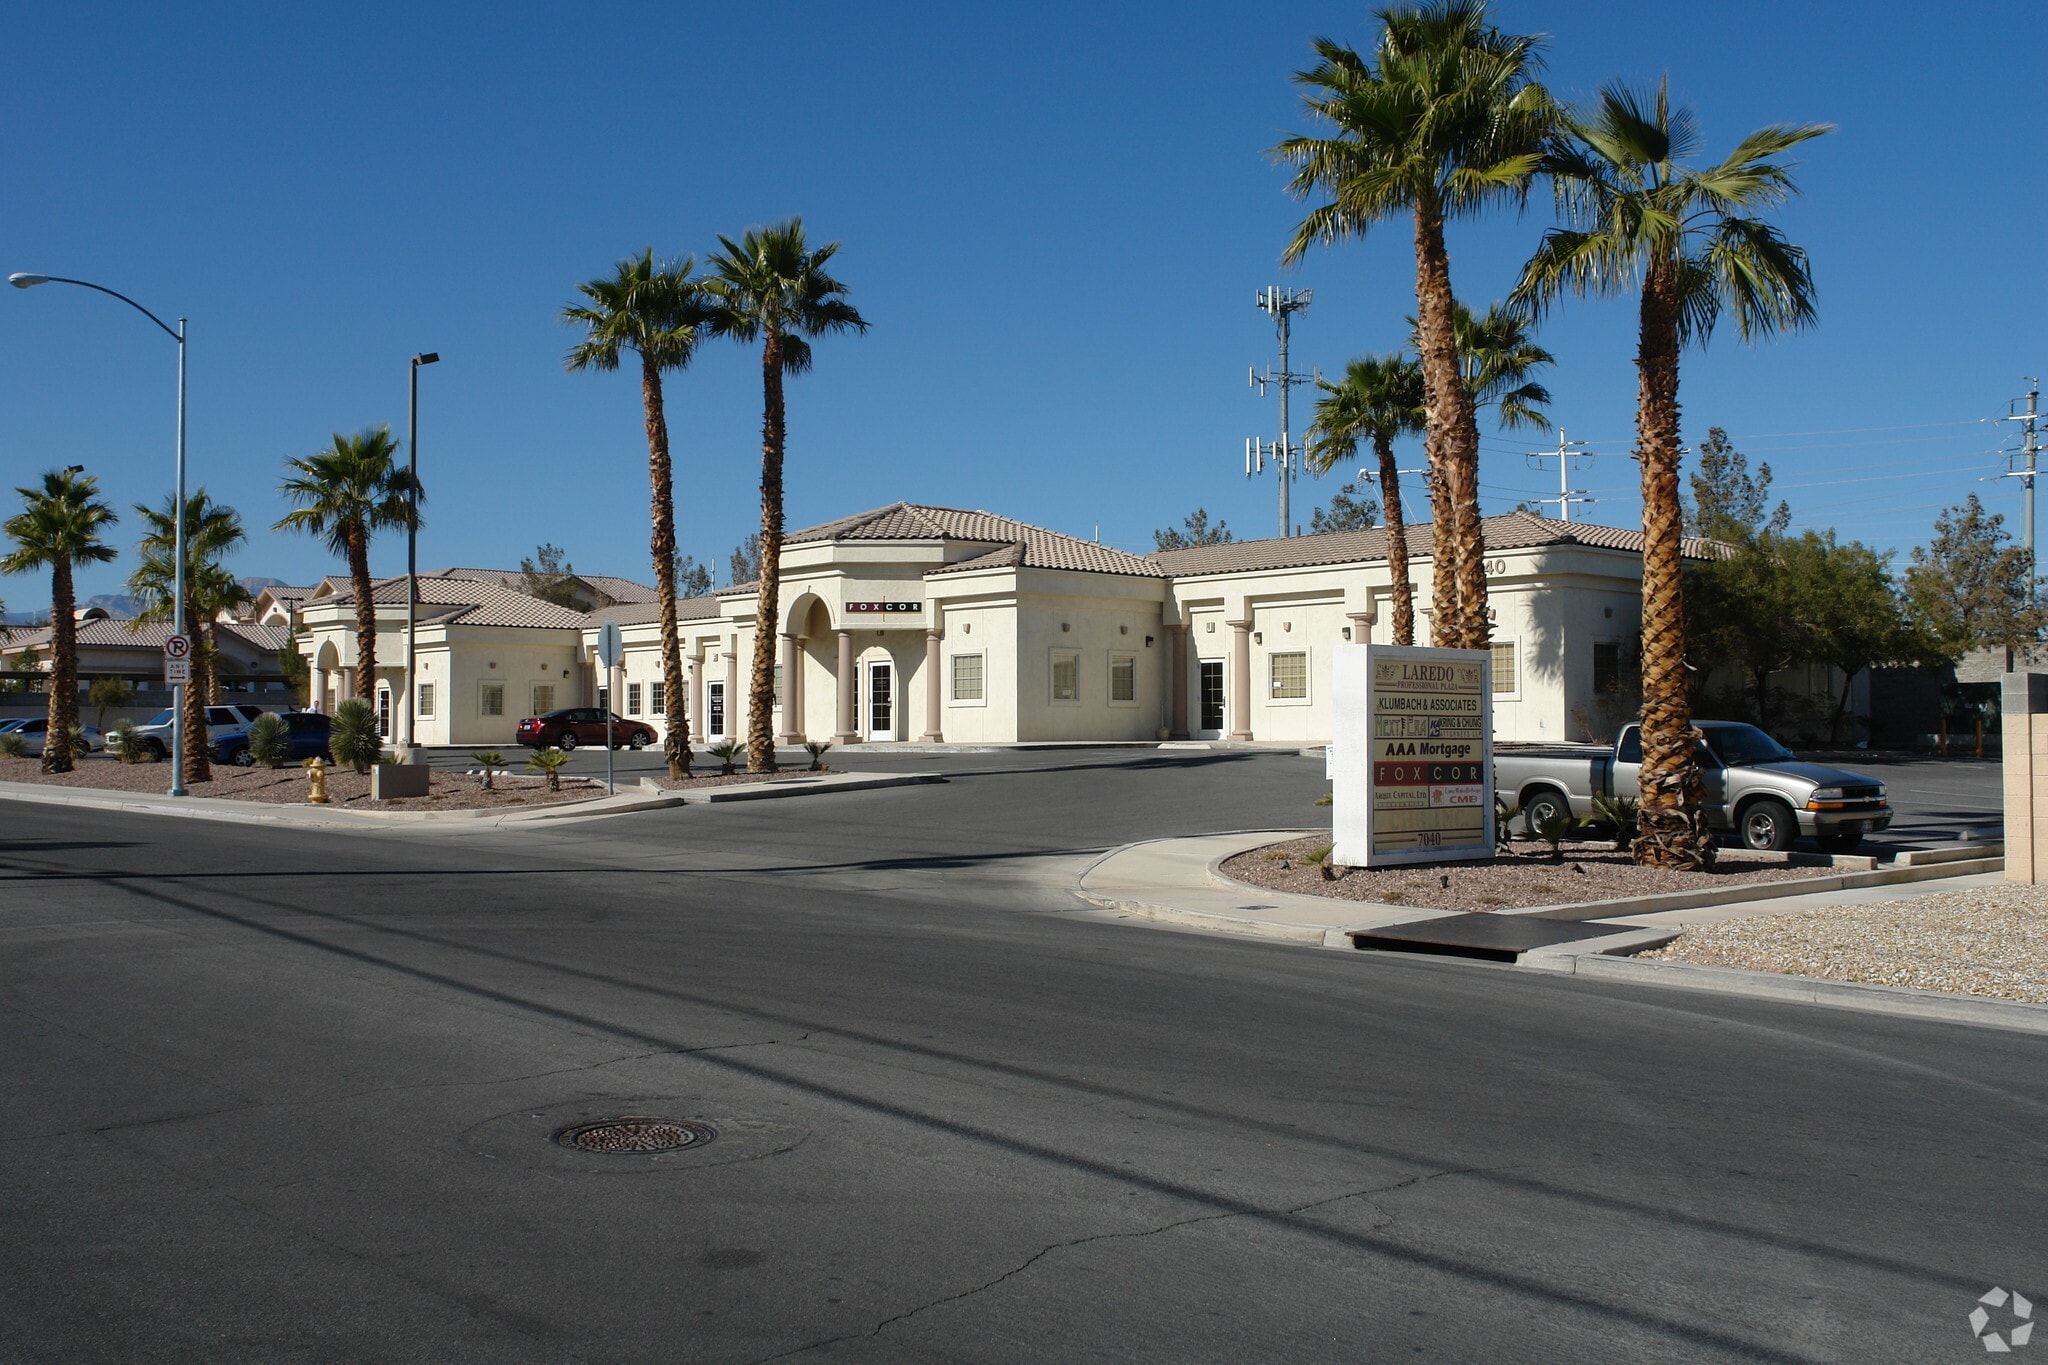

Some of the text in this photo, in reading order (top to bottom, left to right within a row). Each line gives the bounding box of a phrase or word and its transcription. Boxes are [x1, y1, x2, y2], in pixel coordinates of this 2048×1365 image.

[1485, 559, 1506, 575] 40
[849, 603, 918, 611] FOXCOR
[1403, 664, 1454, 682] LAREDO
[1397, 681, 1459, 691] PROFESSIONAL PLAZA
[1379, 697, 1477, 712] KLUMBACH & ASSOCIATES
[1456, 718, 1461, 728] &
[1461, 717, 1482, 728] CHUNG
[1385, 742, 1471, 758] AAA Mortgage
[1449, 795, 1478, 804] CMB
[1418, 832, 1441, 847] 7040
